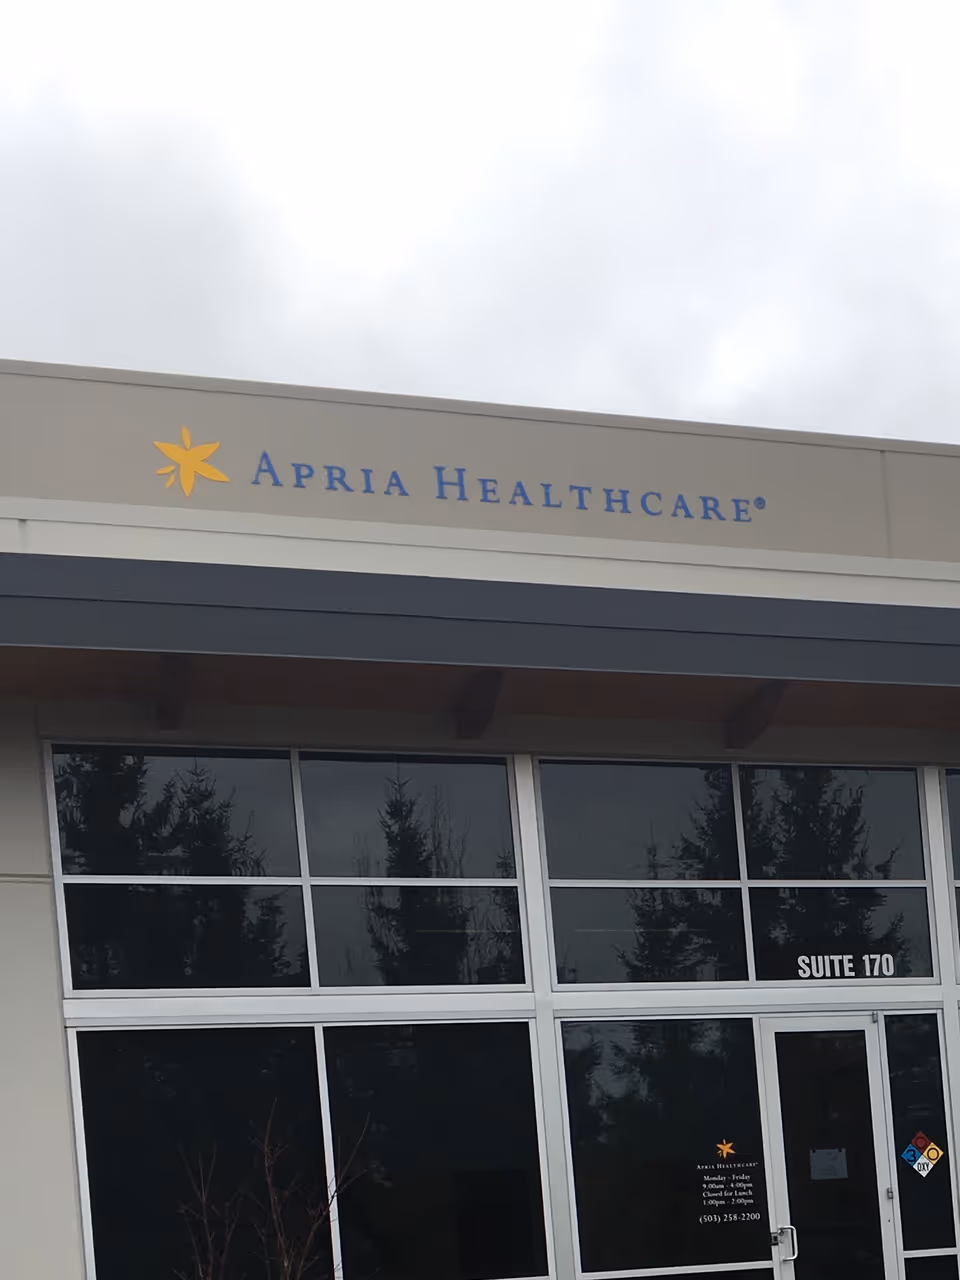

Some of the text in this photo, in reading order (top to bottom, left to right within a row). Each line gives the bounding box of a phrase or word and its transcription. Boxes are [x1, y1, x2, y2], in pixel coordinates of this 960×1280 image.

[250, 449, 410, 498] APRIA
[797, 953, 895, 978] SUITE 170
[906, 1148, 939, 1162] 3 0
[917, 1162, 929, 1171] OXY
[732, 1173, 751, 1181] Friday
[702, 1190, 723, 1198] Closed
[699, 1212, 761, 1224] (503) 258-2200
